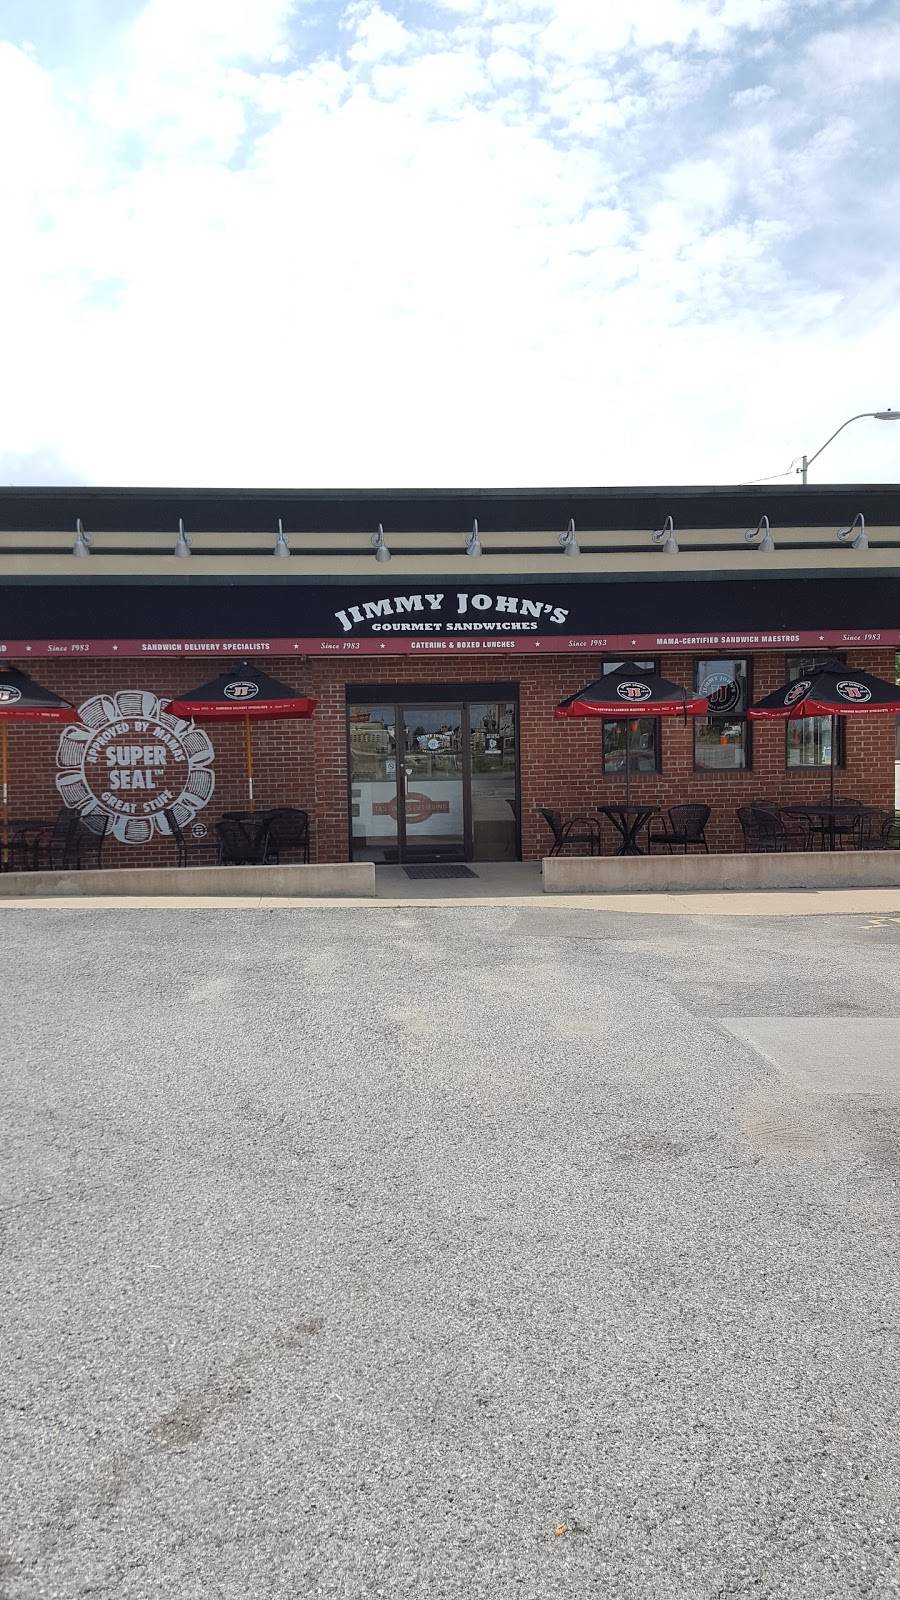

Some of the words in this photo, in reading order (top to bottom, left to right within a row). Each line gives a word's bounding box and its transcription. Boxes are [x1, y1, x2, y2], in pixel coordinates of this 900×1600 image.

[334, 593, 444, 632] JIMMY
[456, 593, 569, 624] JOHN'S
[371, 622, 442, 631] GOURMET
[446, 621, 538, 631] SANDWICHES
[656, 636, 719, 645] MAMA-CERTIFIED
[721, 636, 759, 644] SANDWICH
[761, 634, 800, 643] MAESTROS
[863, 633, 881, 641] 1983
[47, 644, 68, 652] Since
[71, 644, 90, 652] 1983
[142, 643, 182, 651] SANDWICH
[184, 643, 220, 651] DELIVERY
[320, 642, 340, 650] Since
[411, 641, 447, 649] CATERING
[482, 640, 515, 648] LUNCHES
[589, 639, 608, 647] 1983
[87, 721, 130, 764] APPROVED
[134, 721, 150, 733] BY
[152, 727, 186, 763] MAMAS
[105, 745, 167, 767] SUPER
[109, 769, 156, 790] SEAL
[101, 791, 137, 813] GREAT
[142, 789, 175, 813] STUFF
